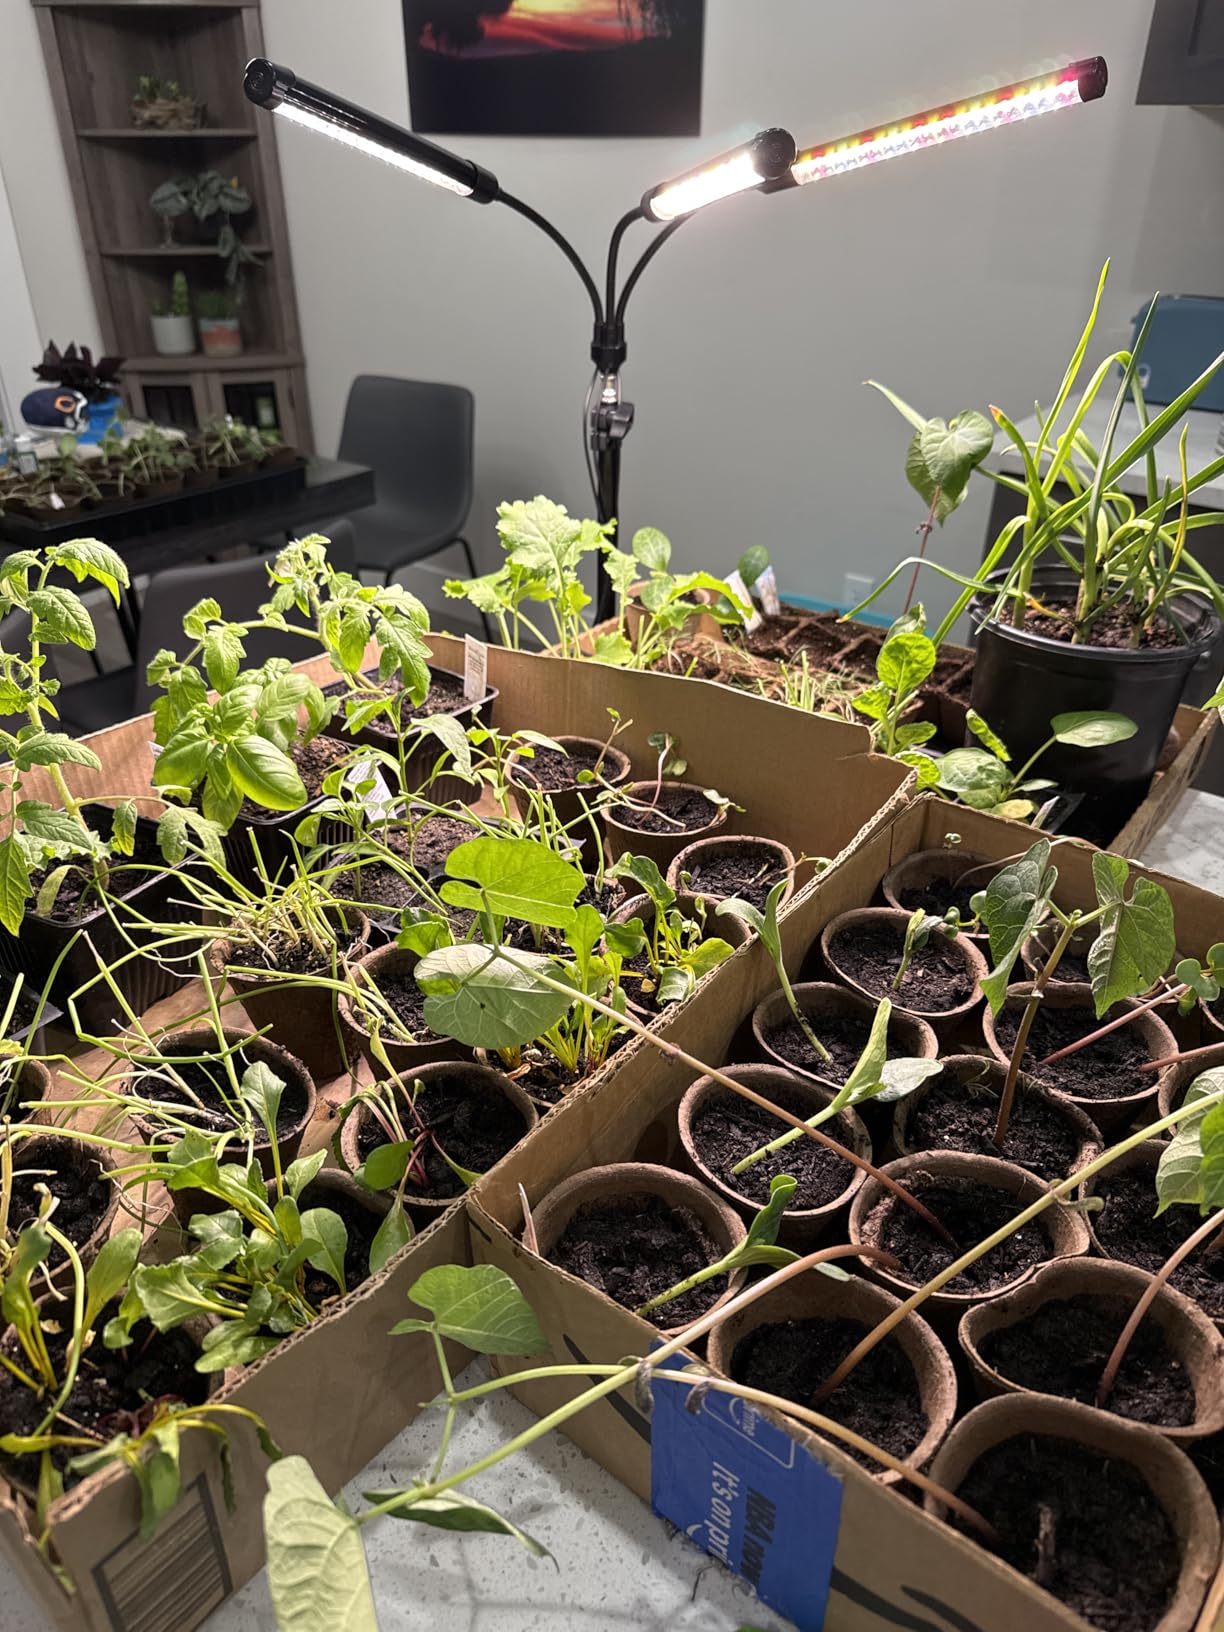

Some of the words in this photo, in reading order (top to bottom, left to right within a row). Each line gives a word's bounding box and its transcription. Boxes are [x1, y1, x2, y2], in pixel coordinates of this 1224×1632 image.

[712, 1461, 740, 1500] It's
[710, 1499, 733, 1527] on
[745, 1486, 776, 1544] NBA
